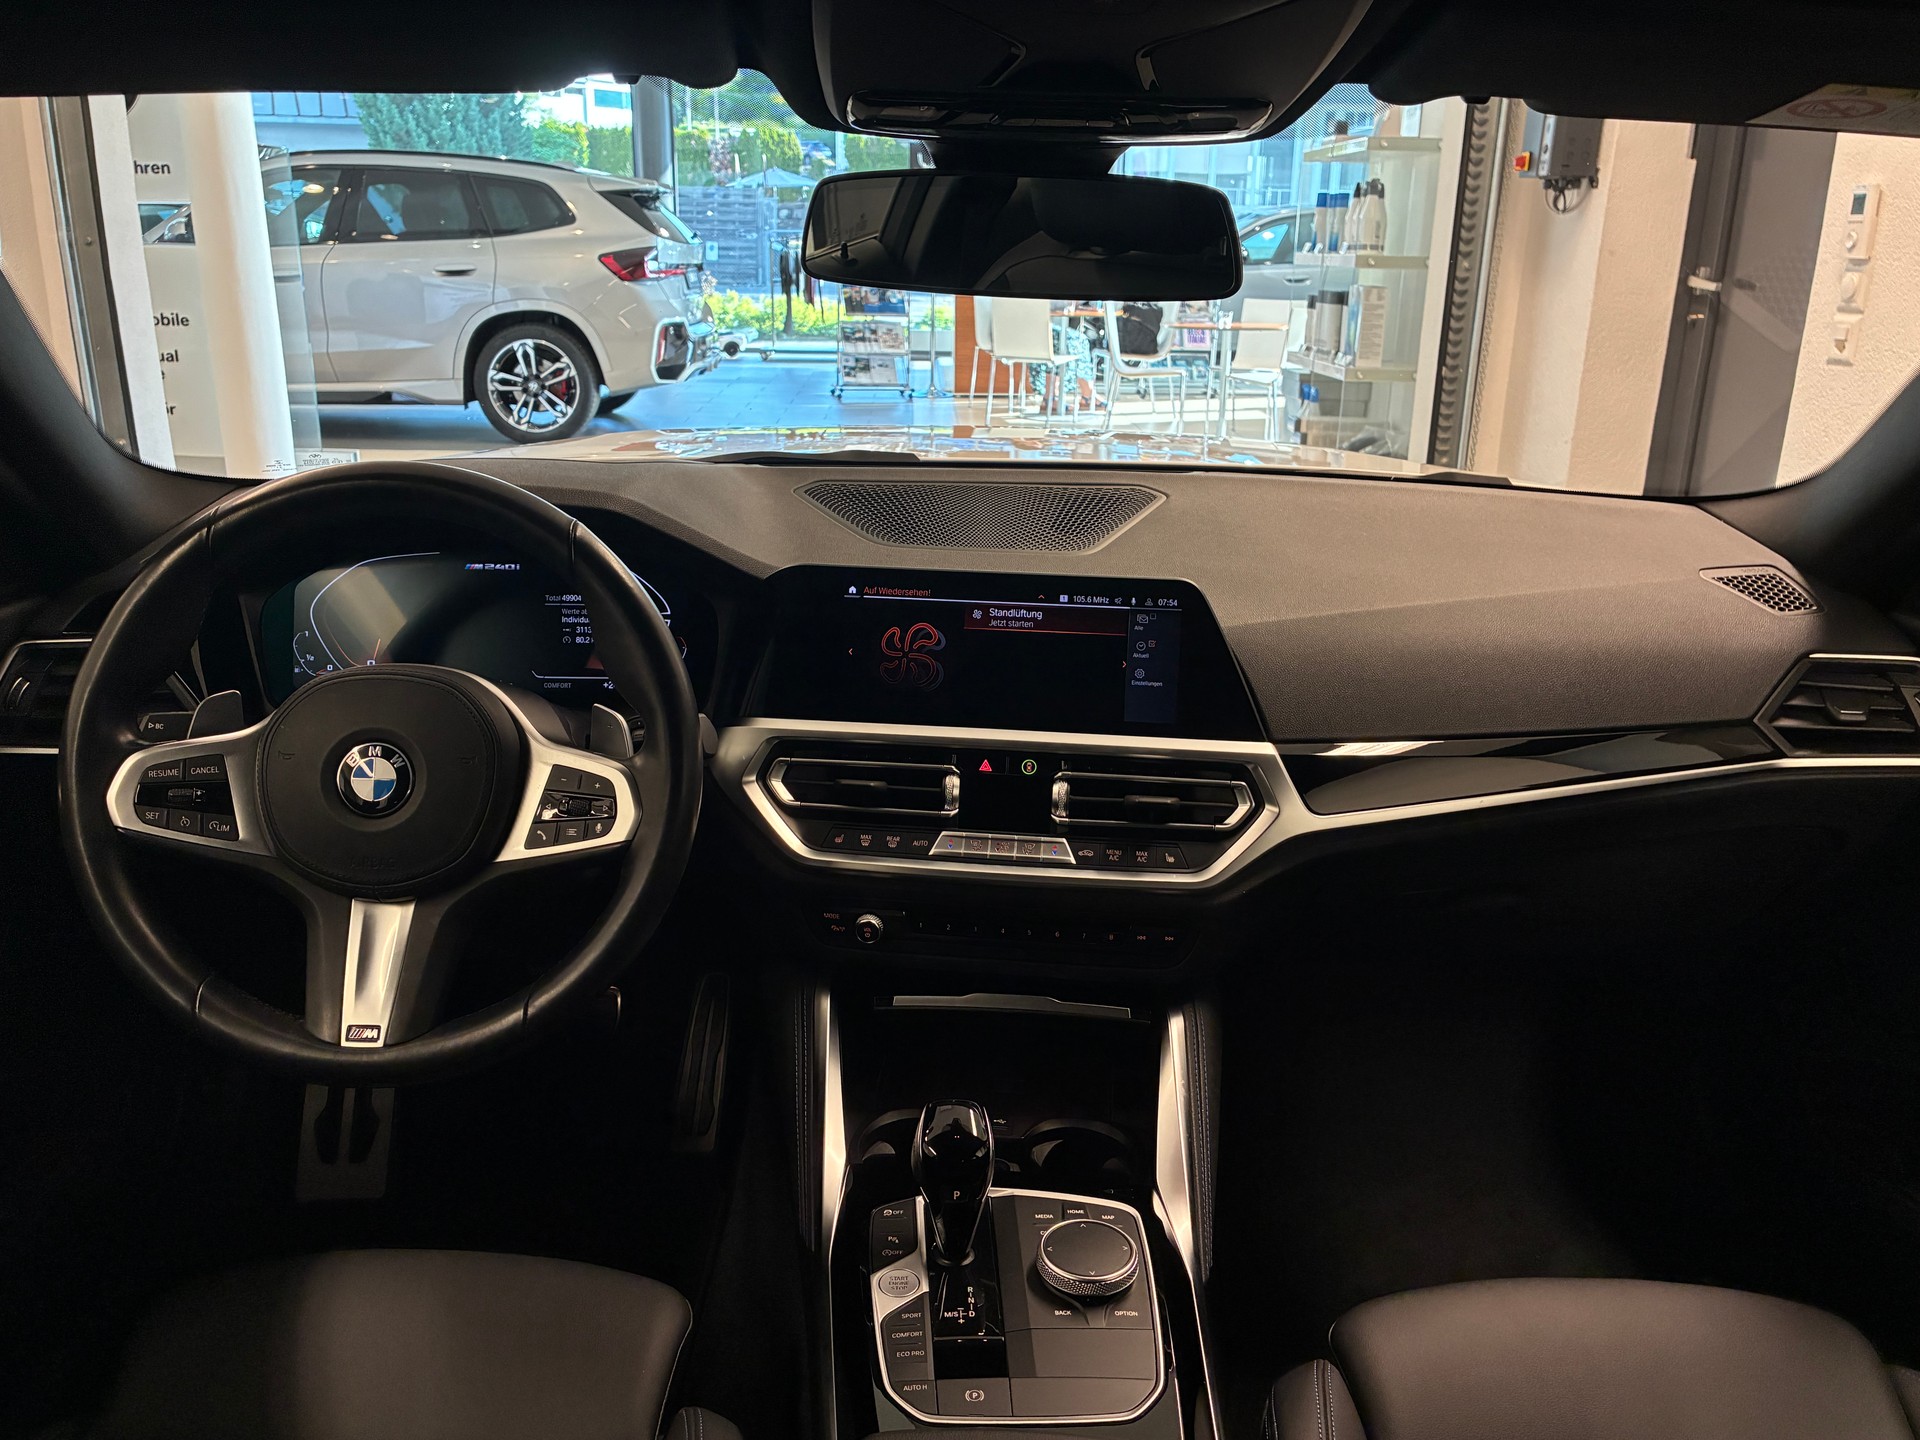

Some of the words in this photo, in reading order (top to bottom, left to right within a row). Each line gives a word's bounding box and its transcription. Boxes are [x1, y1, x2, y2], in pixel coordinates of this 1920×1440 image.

[133, 159, 171, 174] hren
[863, 586, 877, 594] Auf
[878, 587, 931, 597] Wiedersehen!
[545, 594, 561, 602] Total
[561, 594, 582, 602] 49904
[1072, 595, 1092, 603] 105.6
[1092, 596, 1110, 604] MHz
[1157, 598, 1178, 607] 07:54
[989, 607, 1043, 619] Standlüftung
[989, 619, 1007, 627] Jetzt
[1008, 619, 1034, 628] starten
[575, 636, 590, 644] 80.2
[148, 768, 179, 778] RESUME
[190, 766, 220, 775] CANCEL
[145, 811, 160, 820] SET
[216, 824, 230, 832] LIM
[953, 1190, 960, 1200] P
[969, 1310, 976, 1318] D
[891, 1331, 924, 1339] COMFORT
[902, 1384, 920, 1392] AUTO
